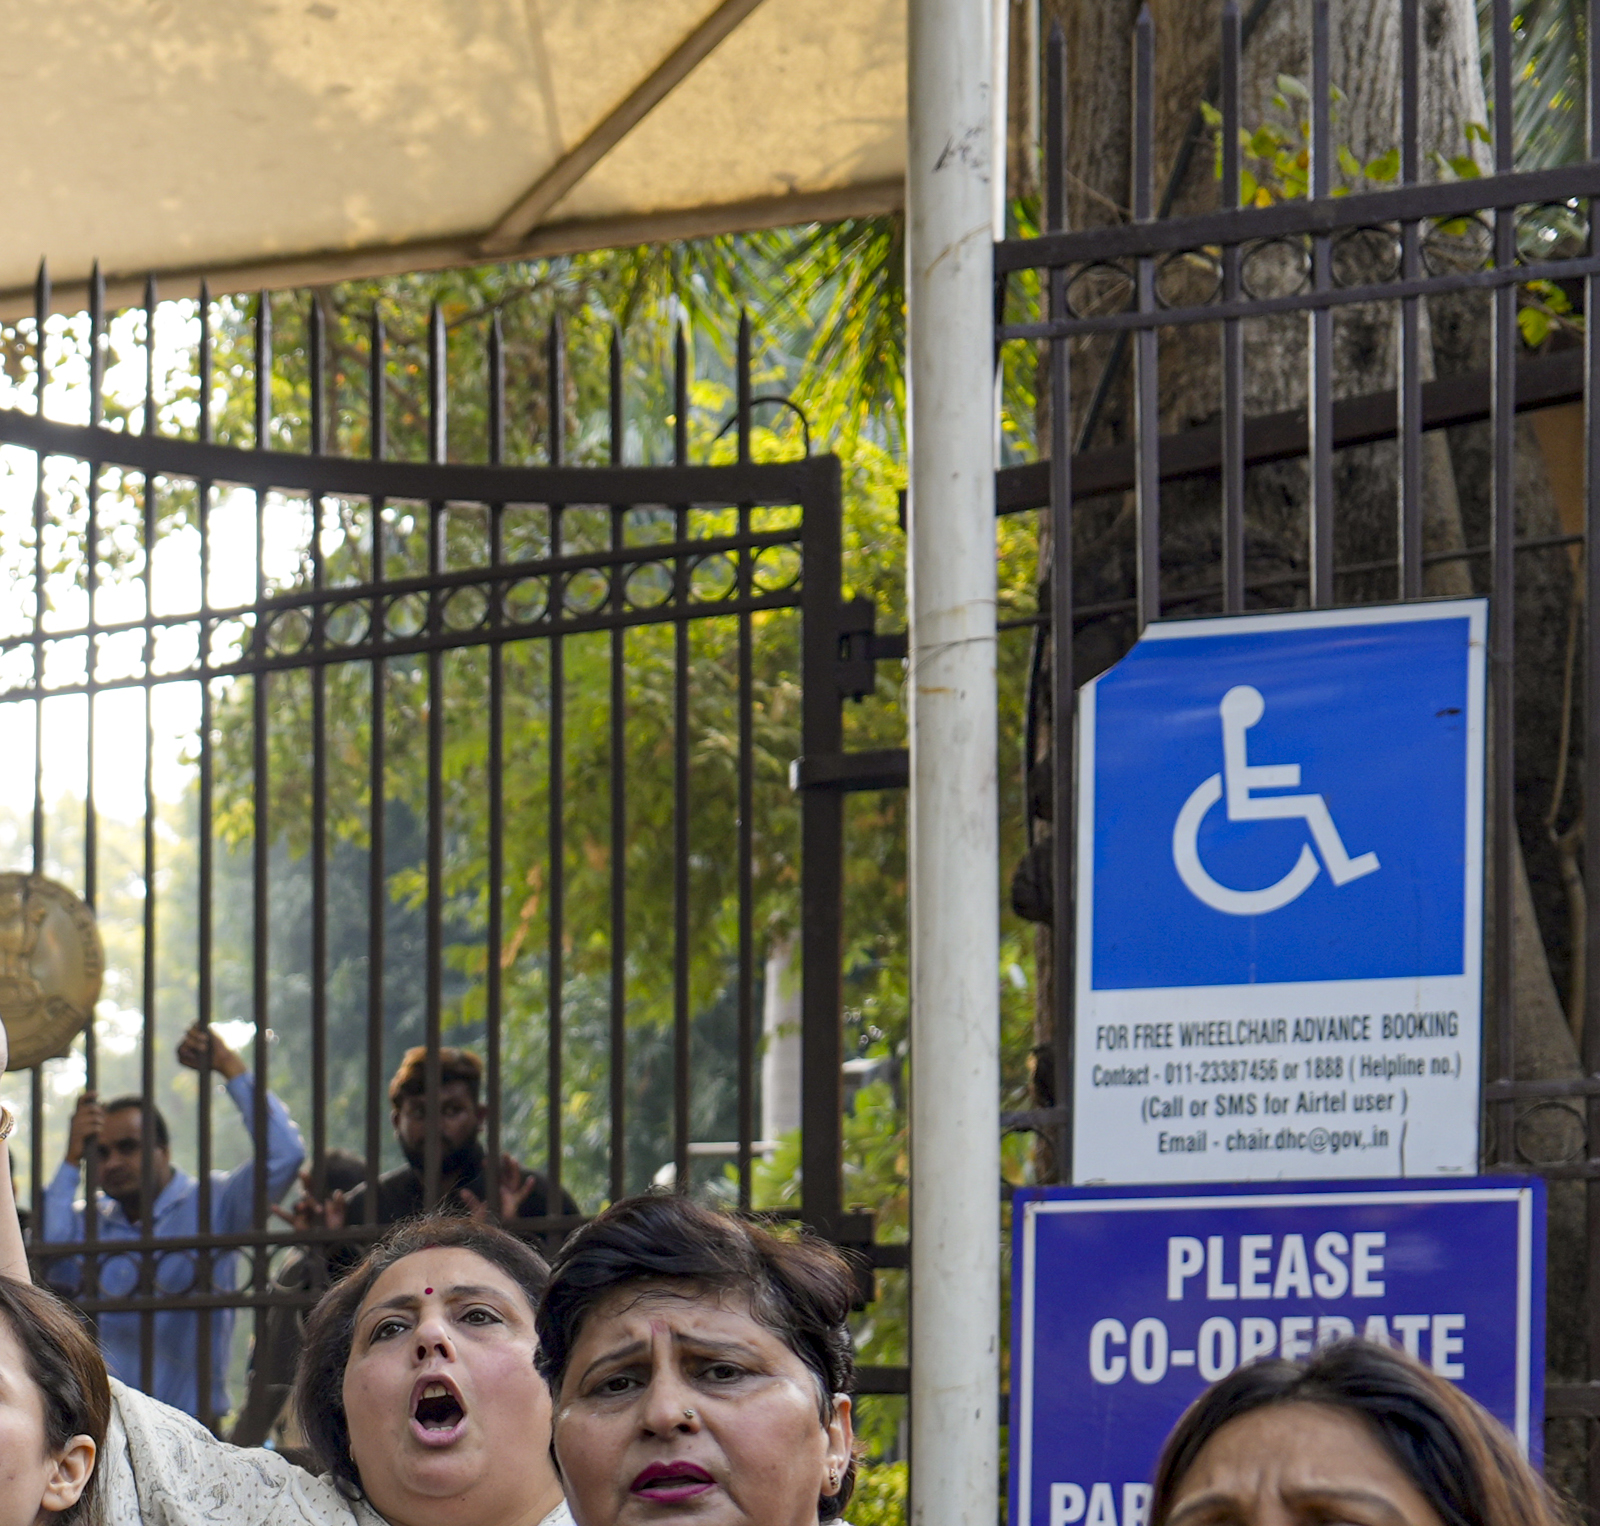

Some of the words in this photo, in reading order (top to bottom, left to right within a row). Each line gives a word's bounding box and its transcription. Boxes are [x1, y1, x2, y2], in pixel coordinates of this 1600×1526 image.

[1096, 1024, 1129, 1050] FOR
[1133, 1022, 1174, 1048] FREE
[1178, 1017, 1288, 1047] WHEELCHAIR
[1291, 1014, 1372, 1043] ADVANCE
[1380, 1010, 1460, 1040] BOOKING
[1092, 1063, 1150, 1087] Contact
[1283, 1062, 1299, 1081] or
[1304, 1055, 1345, 1081] 1888
[1359, 1052, 1426, 1082] Helpline
[1141, 1094, 1184, 1124] (Call
[1189, 1099, 1209, 1119] or
[1214, 1092, 1258, 1117] SMS
[1263, 1091, 1290, 1115] for
[1295, 1089, 1347, 1114] Airtel
[1352, 1093, 1395, 1113] user
[1157, 1129, 1208, 1154] Email
[1166, 1231, 1386, 1301] PLEASE
